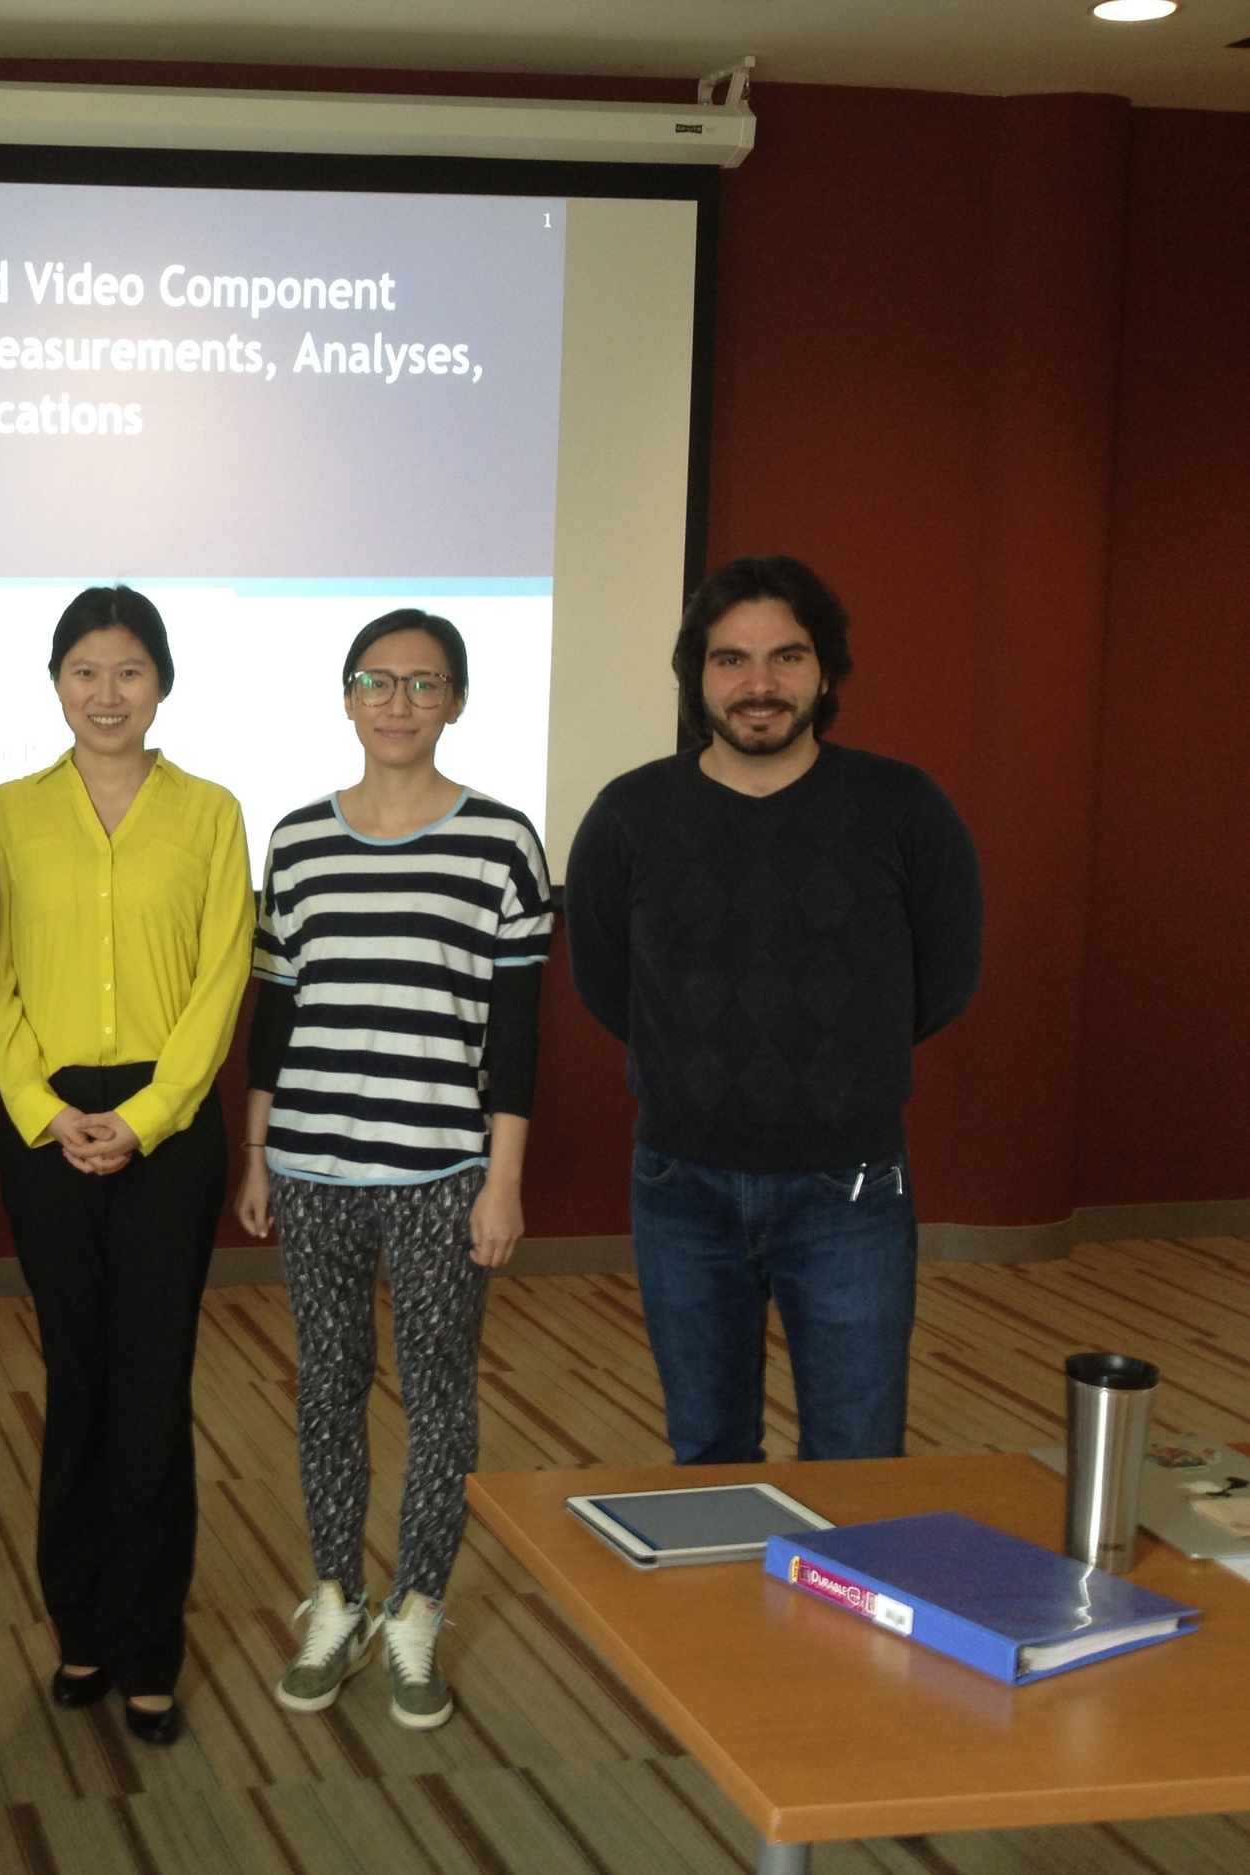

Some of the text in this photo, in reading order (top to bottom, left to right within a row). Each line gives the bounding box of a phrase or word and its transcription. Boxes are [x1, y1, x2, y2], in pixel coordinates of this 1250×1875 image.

[542, 211, 552, 229] 1
[23, 260, 145, 307] Video
[158, 263, 396, 319] Component
[292, 331, 484, 384] Analyses,
